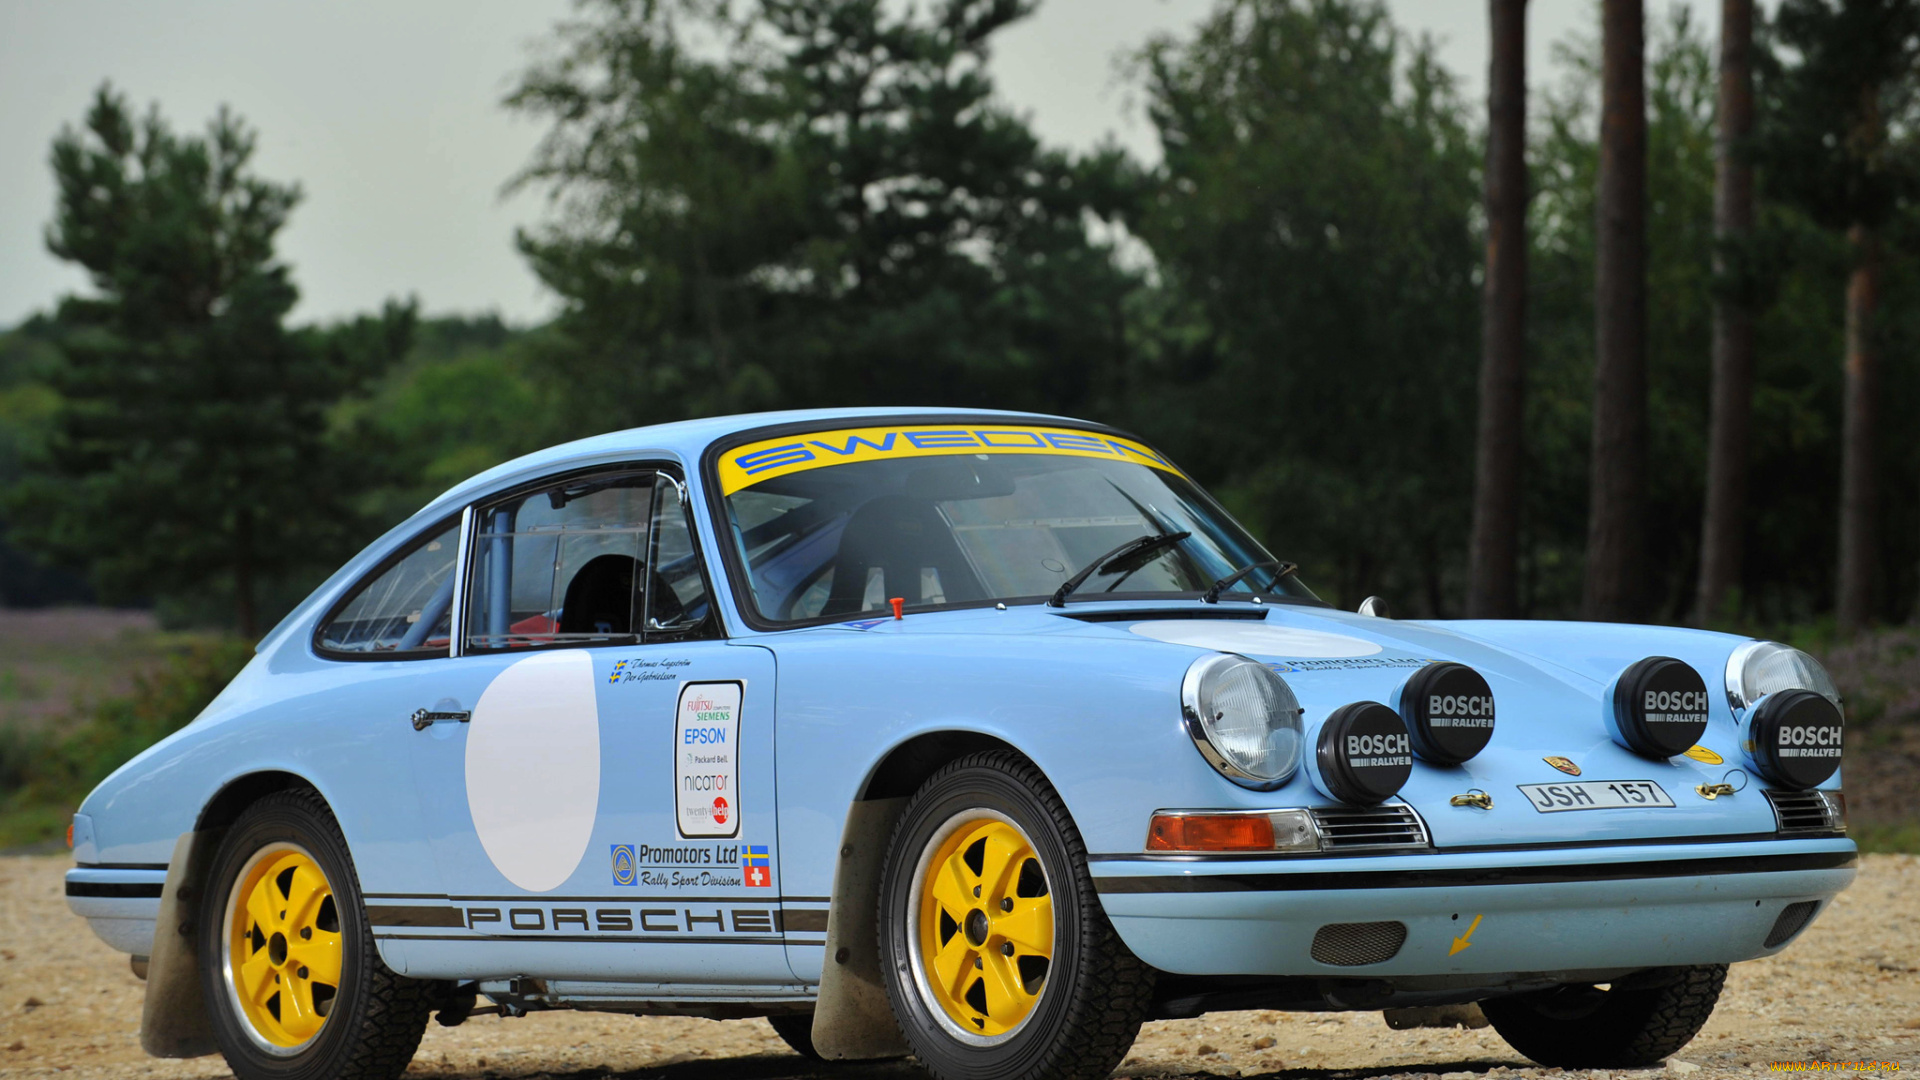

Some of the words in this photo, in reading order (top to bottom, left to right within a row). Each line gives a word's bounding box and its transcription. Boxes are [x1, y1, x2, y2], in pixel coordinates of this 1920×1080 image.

[735, 430, 1172, 475] SWEDEN
[630, 658, 658, 669] Thomas
[1286, 658, 1386, 666] Promotors
[623, 671, 636, 683] Per
[686, 700, 713, 712] FUJITSU
[1429, 695, 1494, 716] BOSCH
[1646, 691, 1707, 711] BOSCH
[696, 711, 730, 721] SIEMENS
[1666, 713, 1701, 723] RALLYE
[1451, 719, 1488, 728] RALLYE
[684, 728, 726, 744] EPSON
[1778, 726, 1842, 746] BOSCH
[1347, 734, 1410, 755] BOSCH
[695, 756, 716, 764] Packard
[1800, 748, 1835, 758] RALLYE
[1370, 757, 1405, 767] RALLYE
[1536, 785, 1595, 808] JSH
[1608, 783, 1660, 804] 157
[639, 844, 711, 864] Promotors
[716, 844, 738, 864] Ltd
[641, 871, 669, 889] Rally
[671, 871, 699, 889] Sport
[701, 871, 741, 887] Division
[466, 907, 772, 932] PORSCHE
